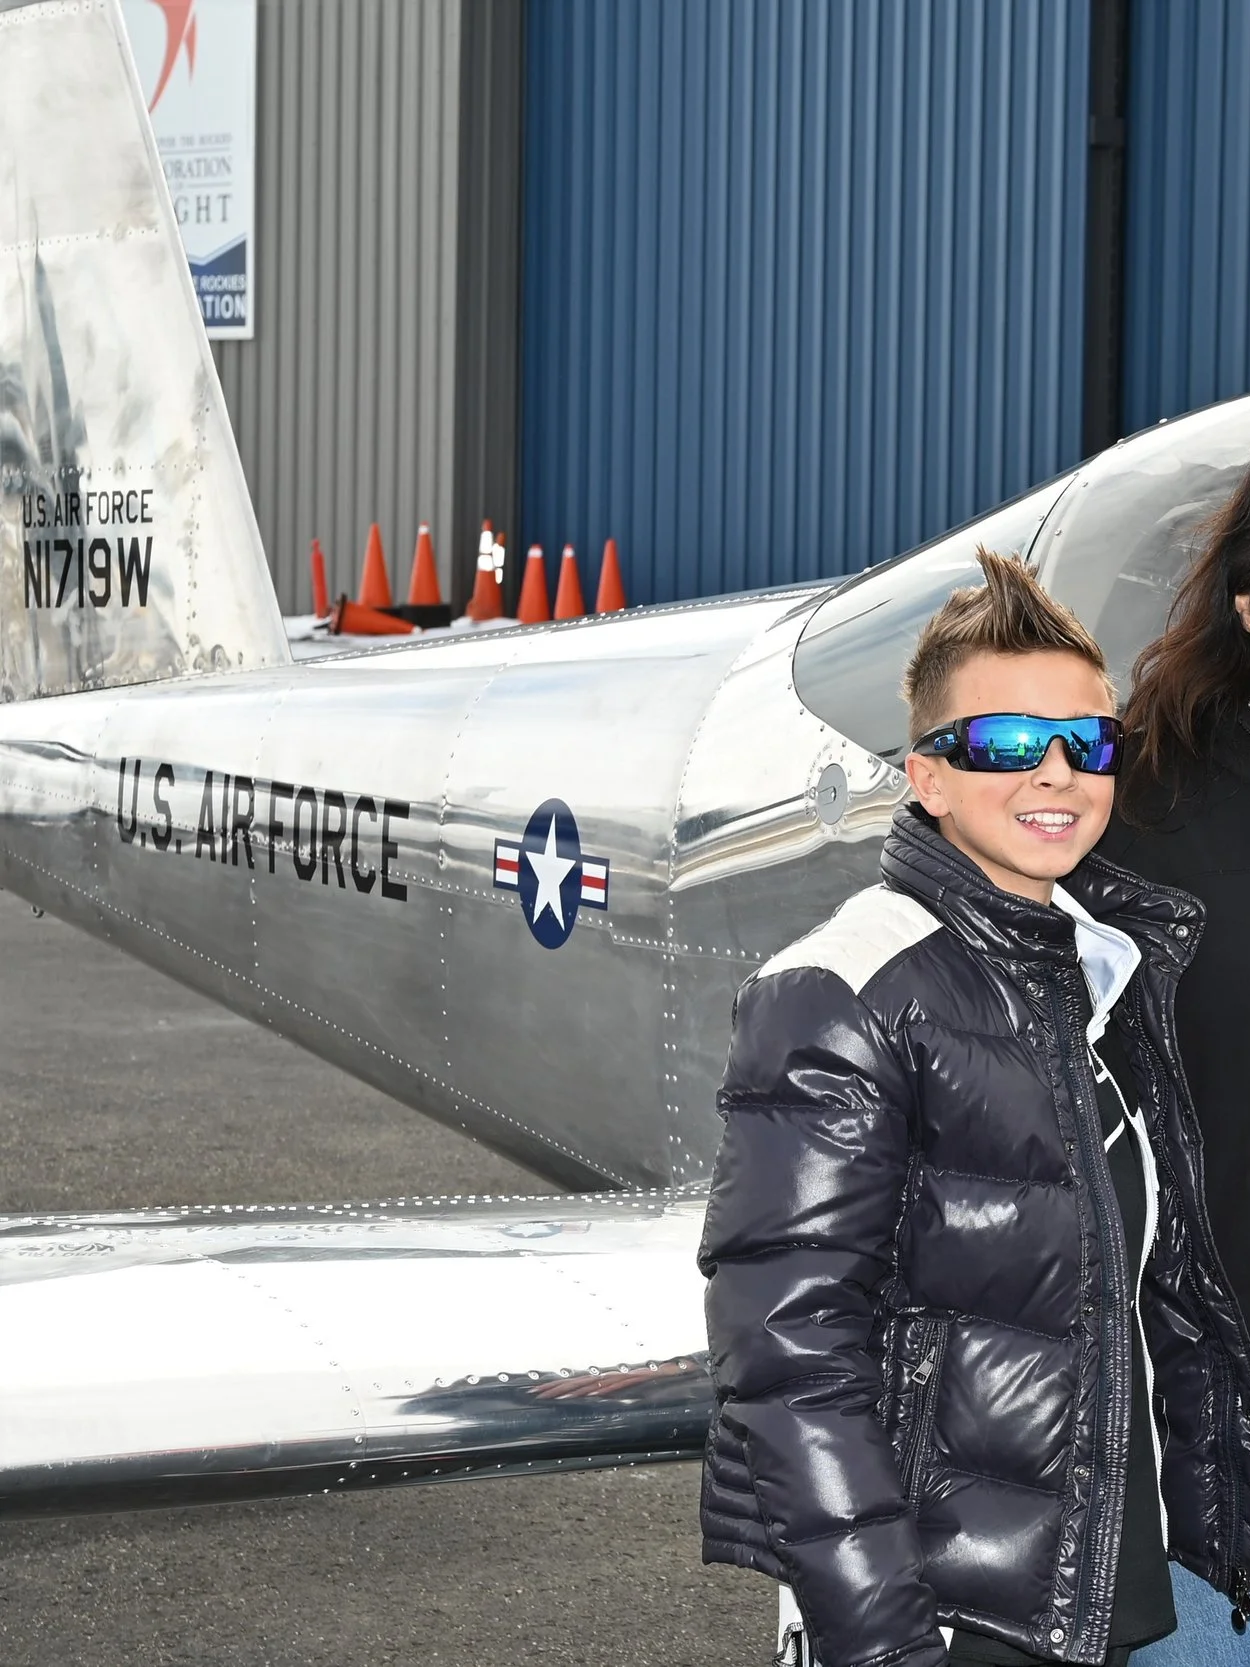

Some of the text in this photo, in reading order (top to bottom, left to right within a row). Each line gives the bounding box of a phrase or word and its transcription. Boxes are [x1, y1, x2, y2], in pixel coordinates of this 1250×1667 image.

[173, 193, 232, 225] GHT
[22, 489, 153, 528] U.S. AIR FORCE
[24, 536, 153, 608] N1719W
[117, 757, 410, 902] U.S. AIR FORCE
